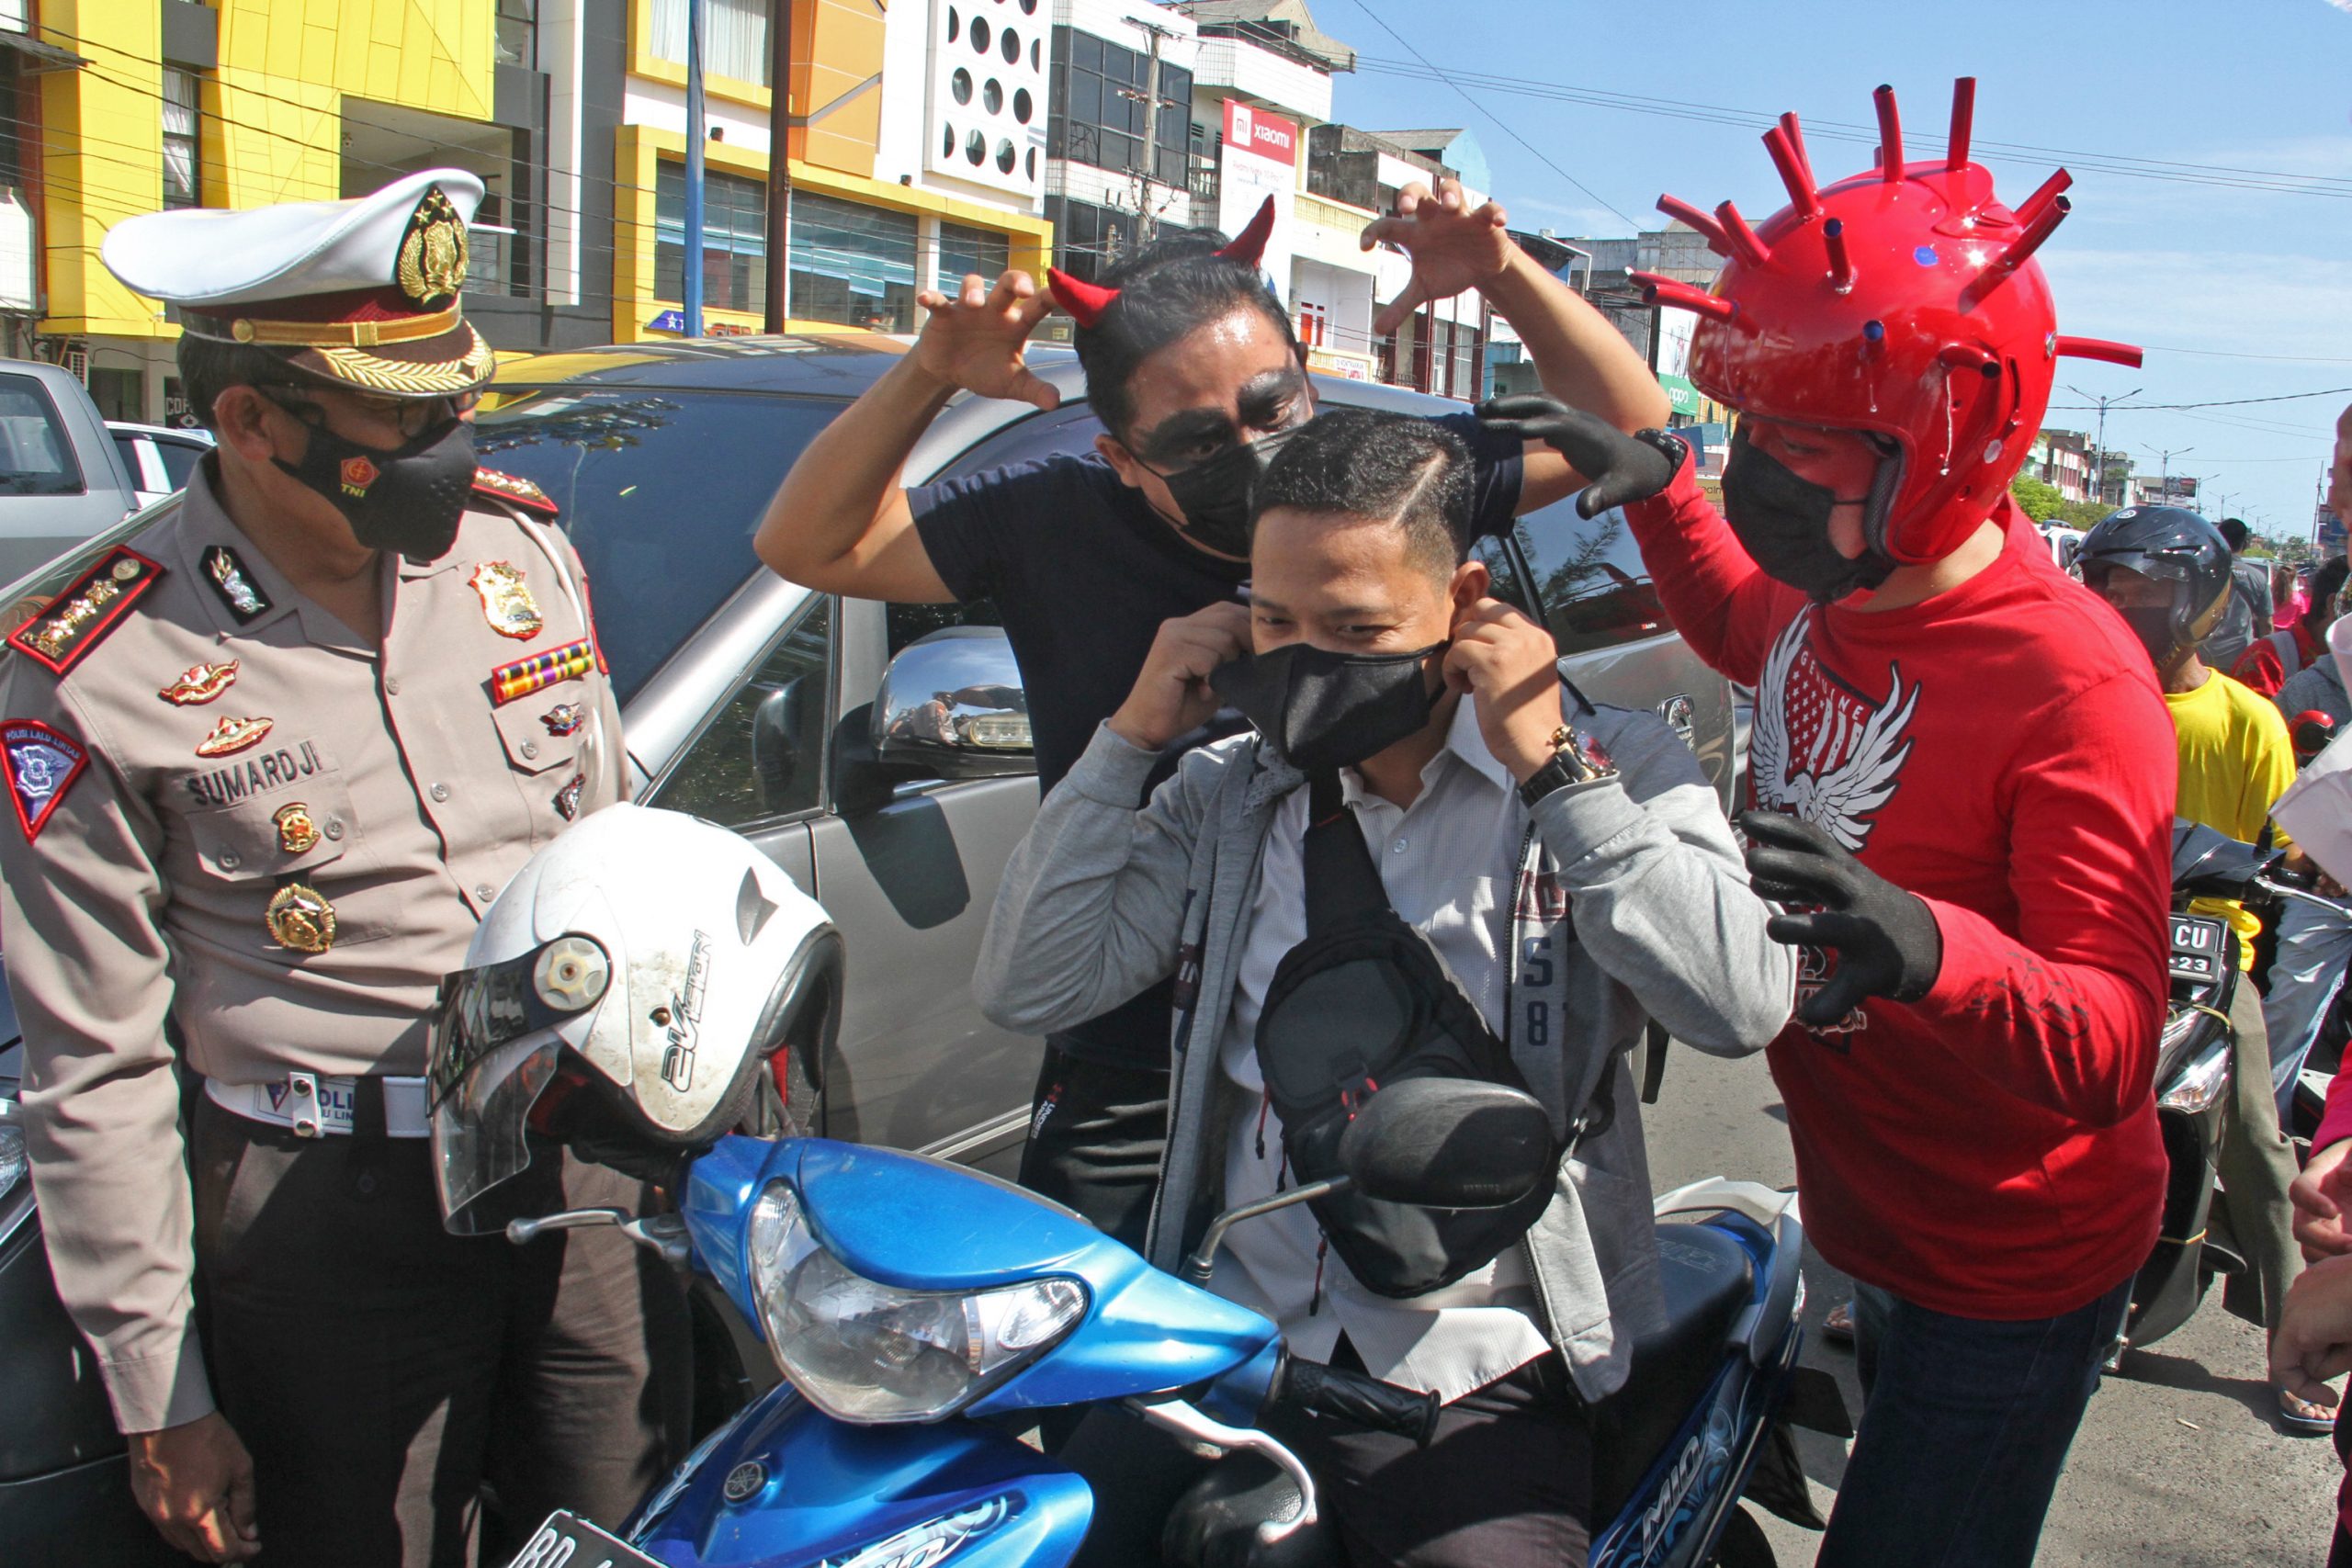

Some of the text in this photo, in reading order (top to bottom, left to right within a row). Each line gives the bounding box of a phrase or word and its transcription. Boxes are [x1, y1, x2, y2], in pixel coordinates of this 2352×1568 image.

[1253, 123, 1290, 149] xiaomi
[1668, 387, 1689, 404] oppo
[341, 483, 366, 498] TNI
[1801, 650, 1864, 721] GENUINE
[187, 740, 323, 805] SUMARDJI
[2175, 924, 2209, 949] CU
[1527, 1000, 1549, 1046] 8
[319, 1089, 354, 1110] OLI
[334, 1110, 353, 1121] LIN
